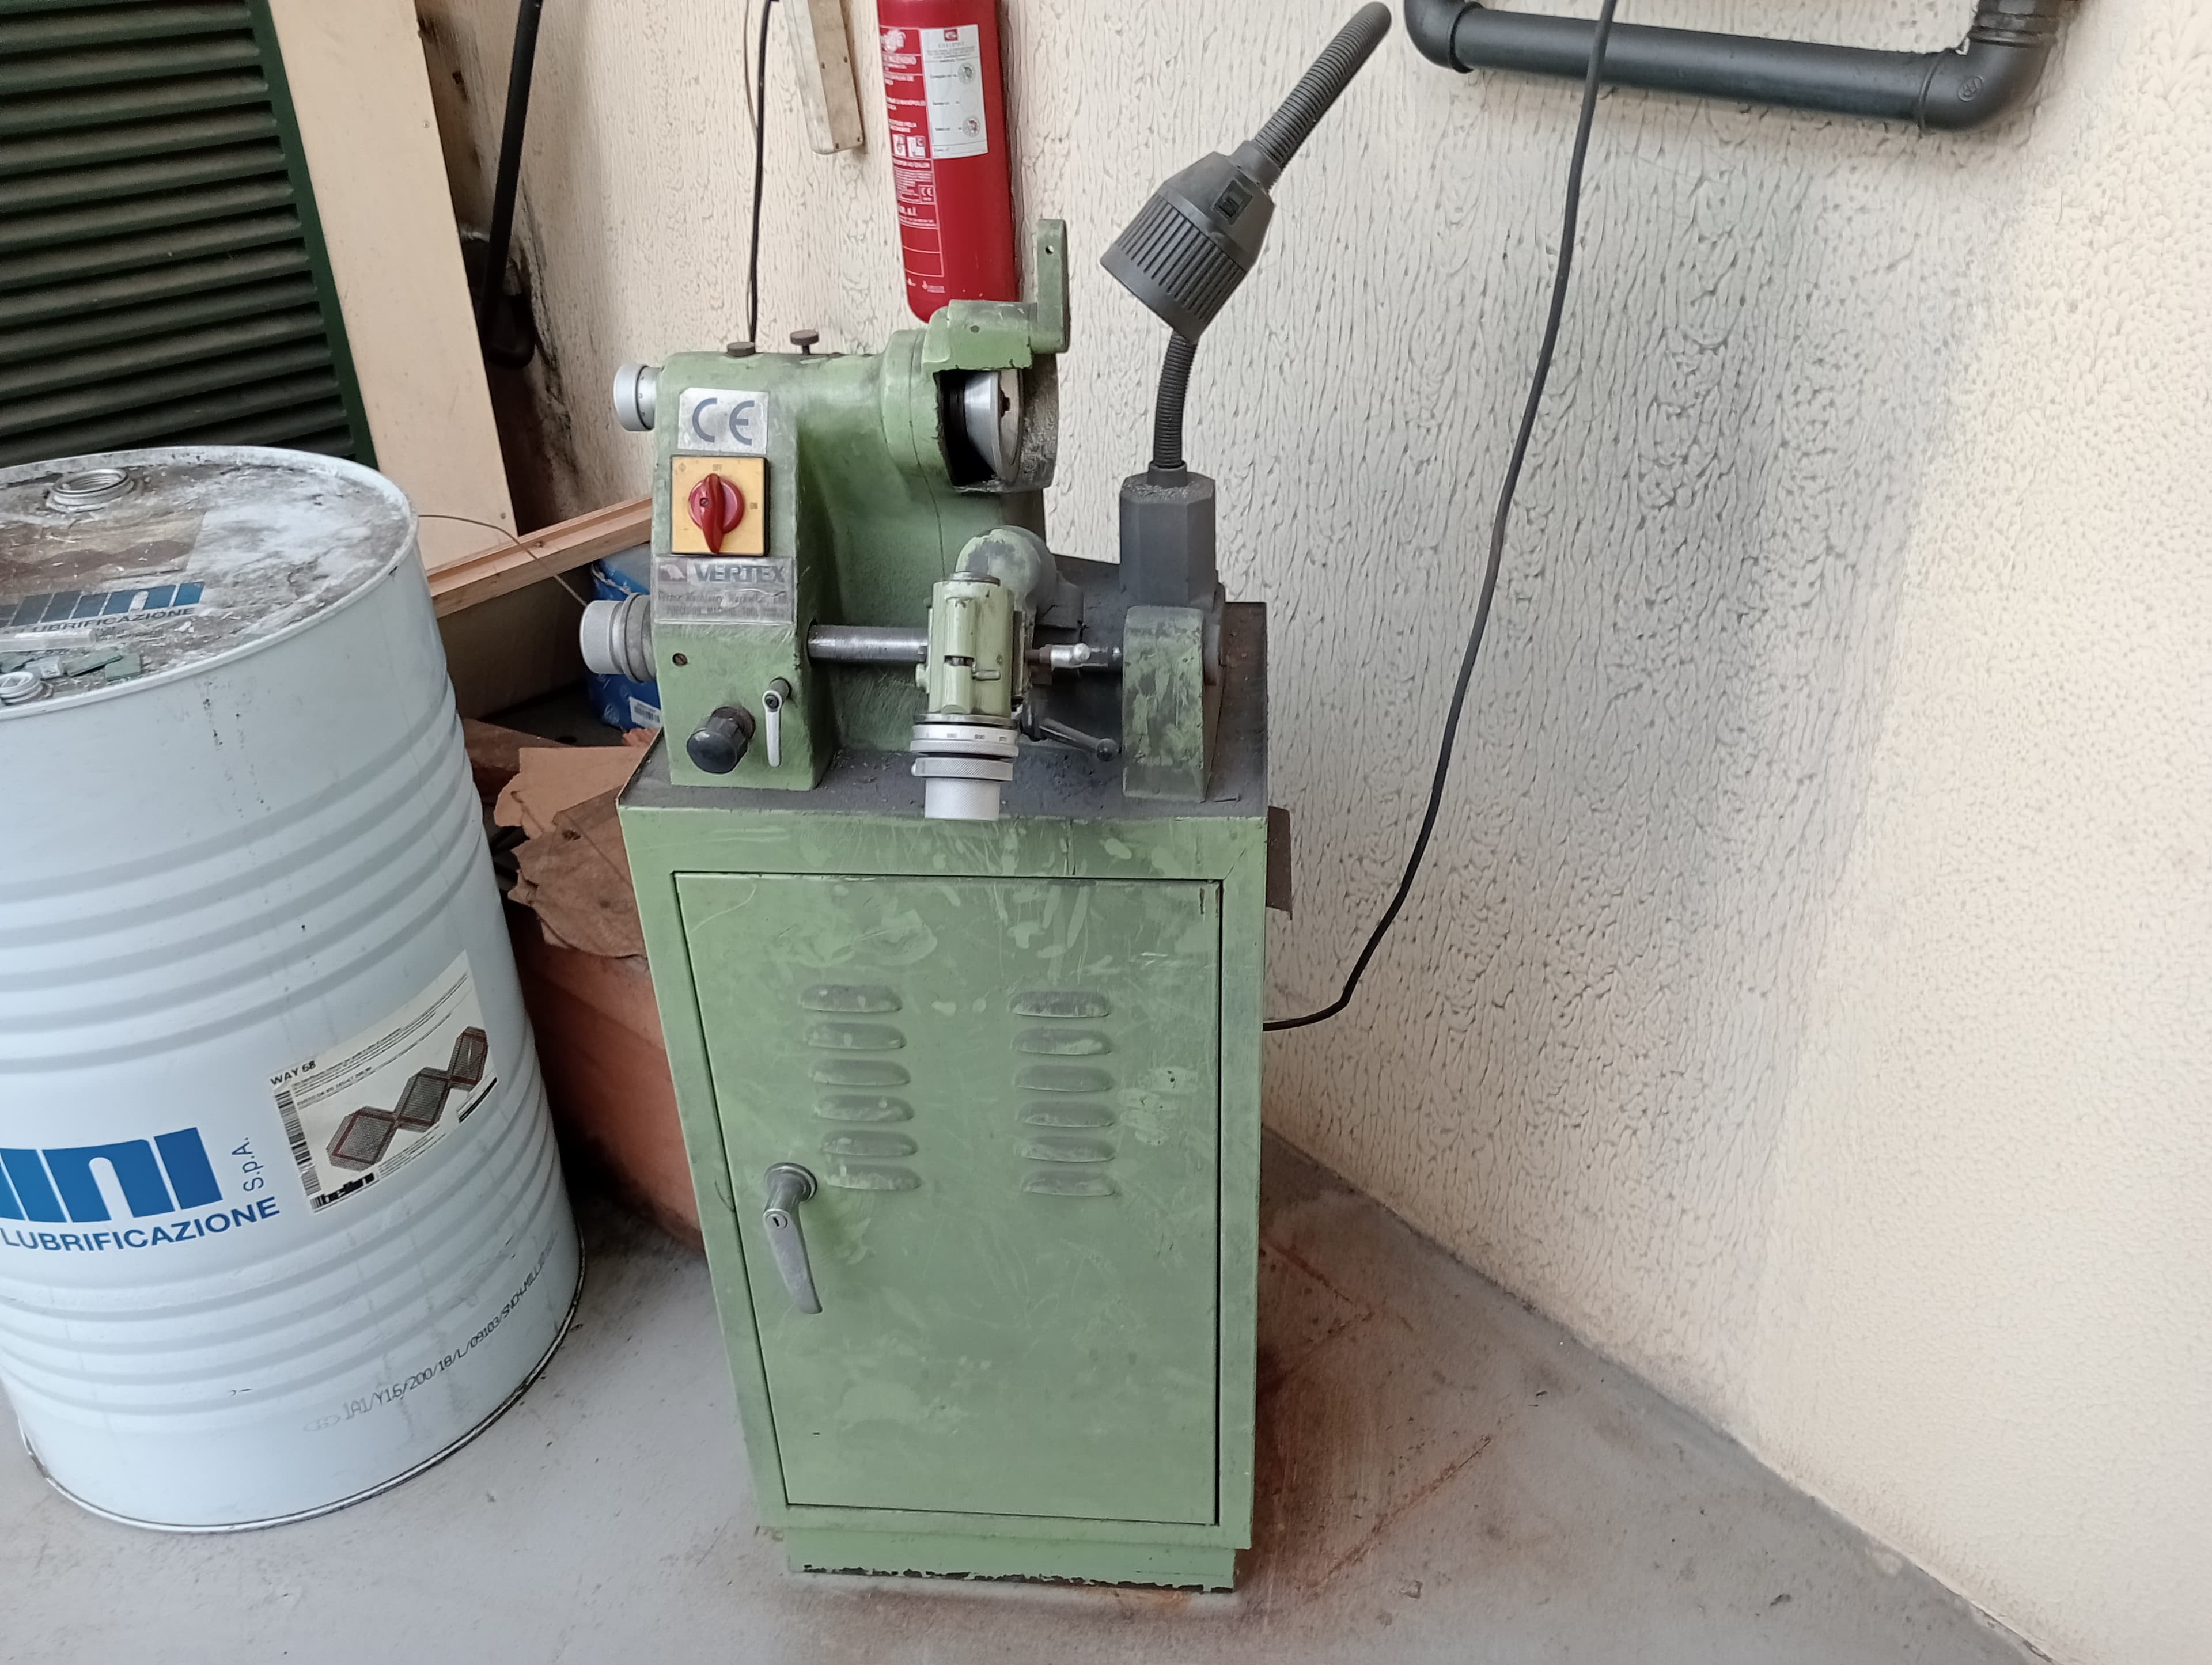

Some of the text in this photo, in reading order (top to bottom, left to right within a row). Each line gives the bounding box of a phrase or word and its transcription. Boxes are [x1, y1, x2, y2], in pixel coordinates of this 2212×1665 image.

[692, 397, 755, 445] CE
[694, 563, 785, 583] VERTEX
[270, 1060, 316, 1086] WAY 68
[232, 1137, 264, 1192] S.p.A.
[0, 1196, 280, 1251] LUBRIFICAZIONE
